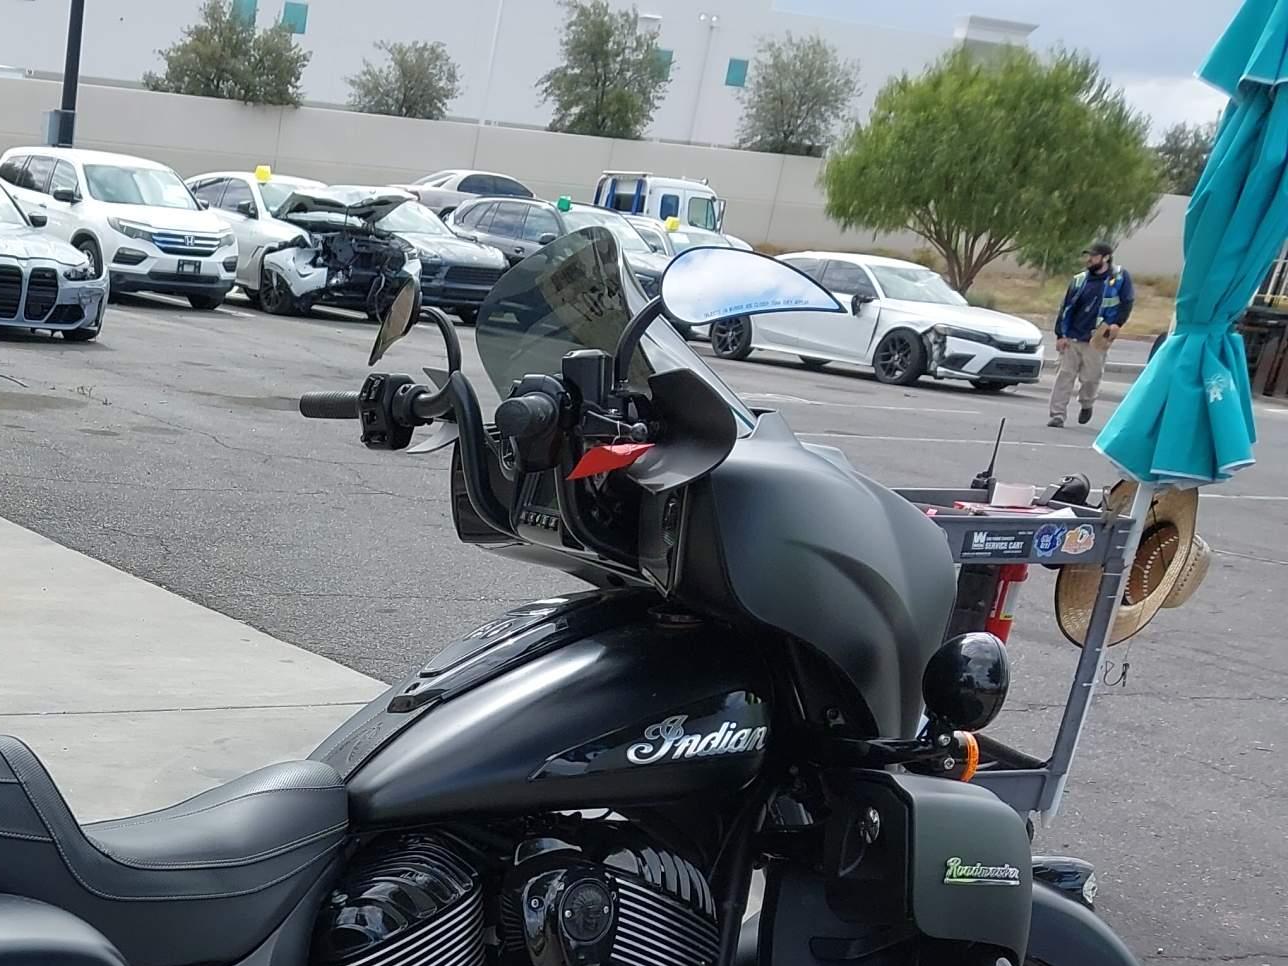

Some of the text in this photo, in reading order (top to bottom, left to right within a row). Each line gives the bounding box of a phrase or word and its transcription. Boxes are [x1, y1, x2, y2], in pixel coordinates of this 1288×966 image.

[985, 542, 1008, 550] SERVICE
[1008, 541, 1025, 549] CART
[627, 715, 768, 765] Indian
[945, 857, 1020, 879] Roadmaster
